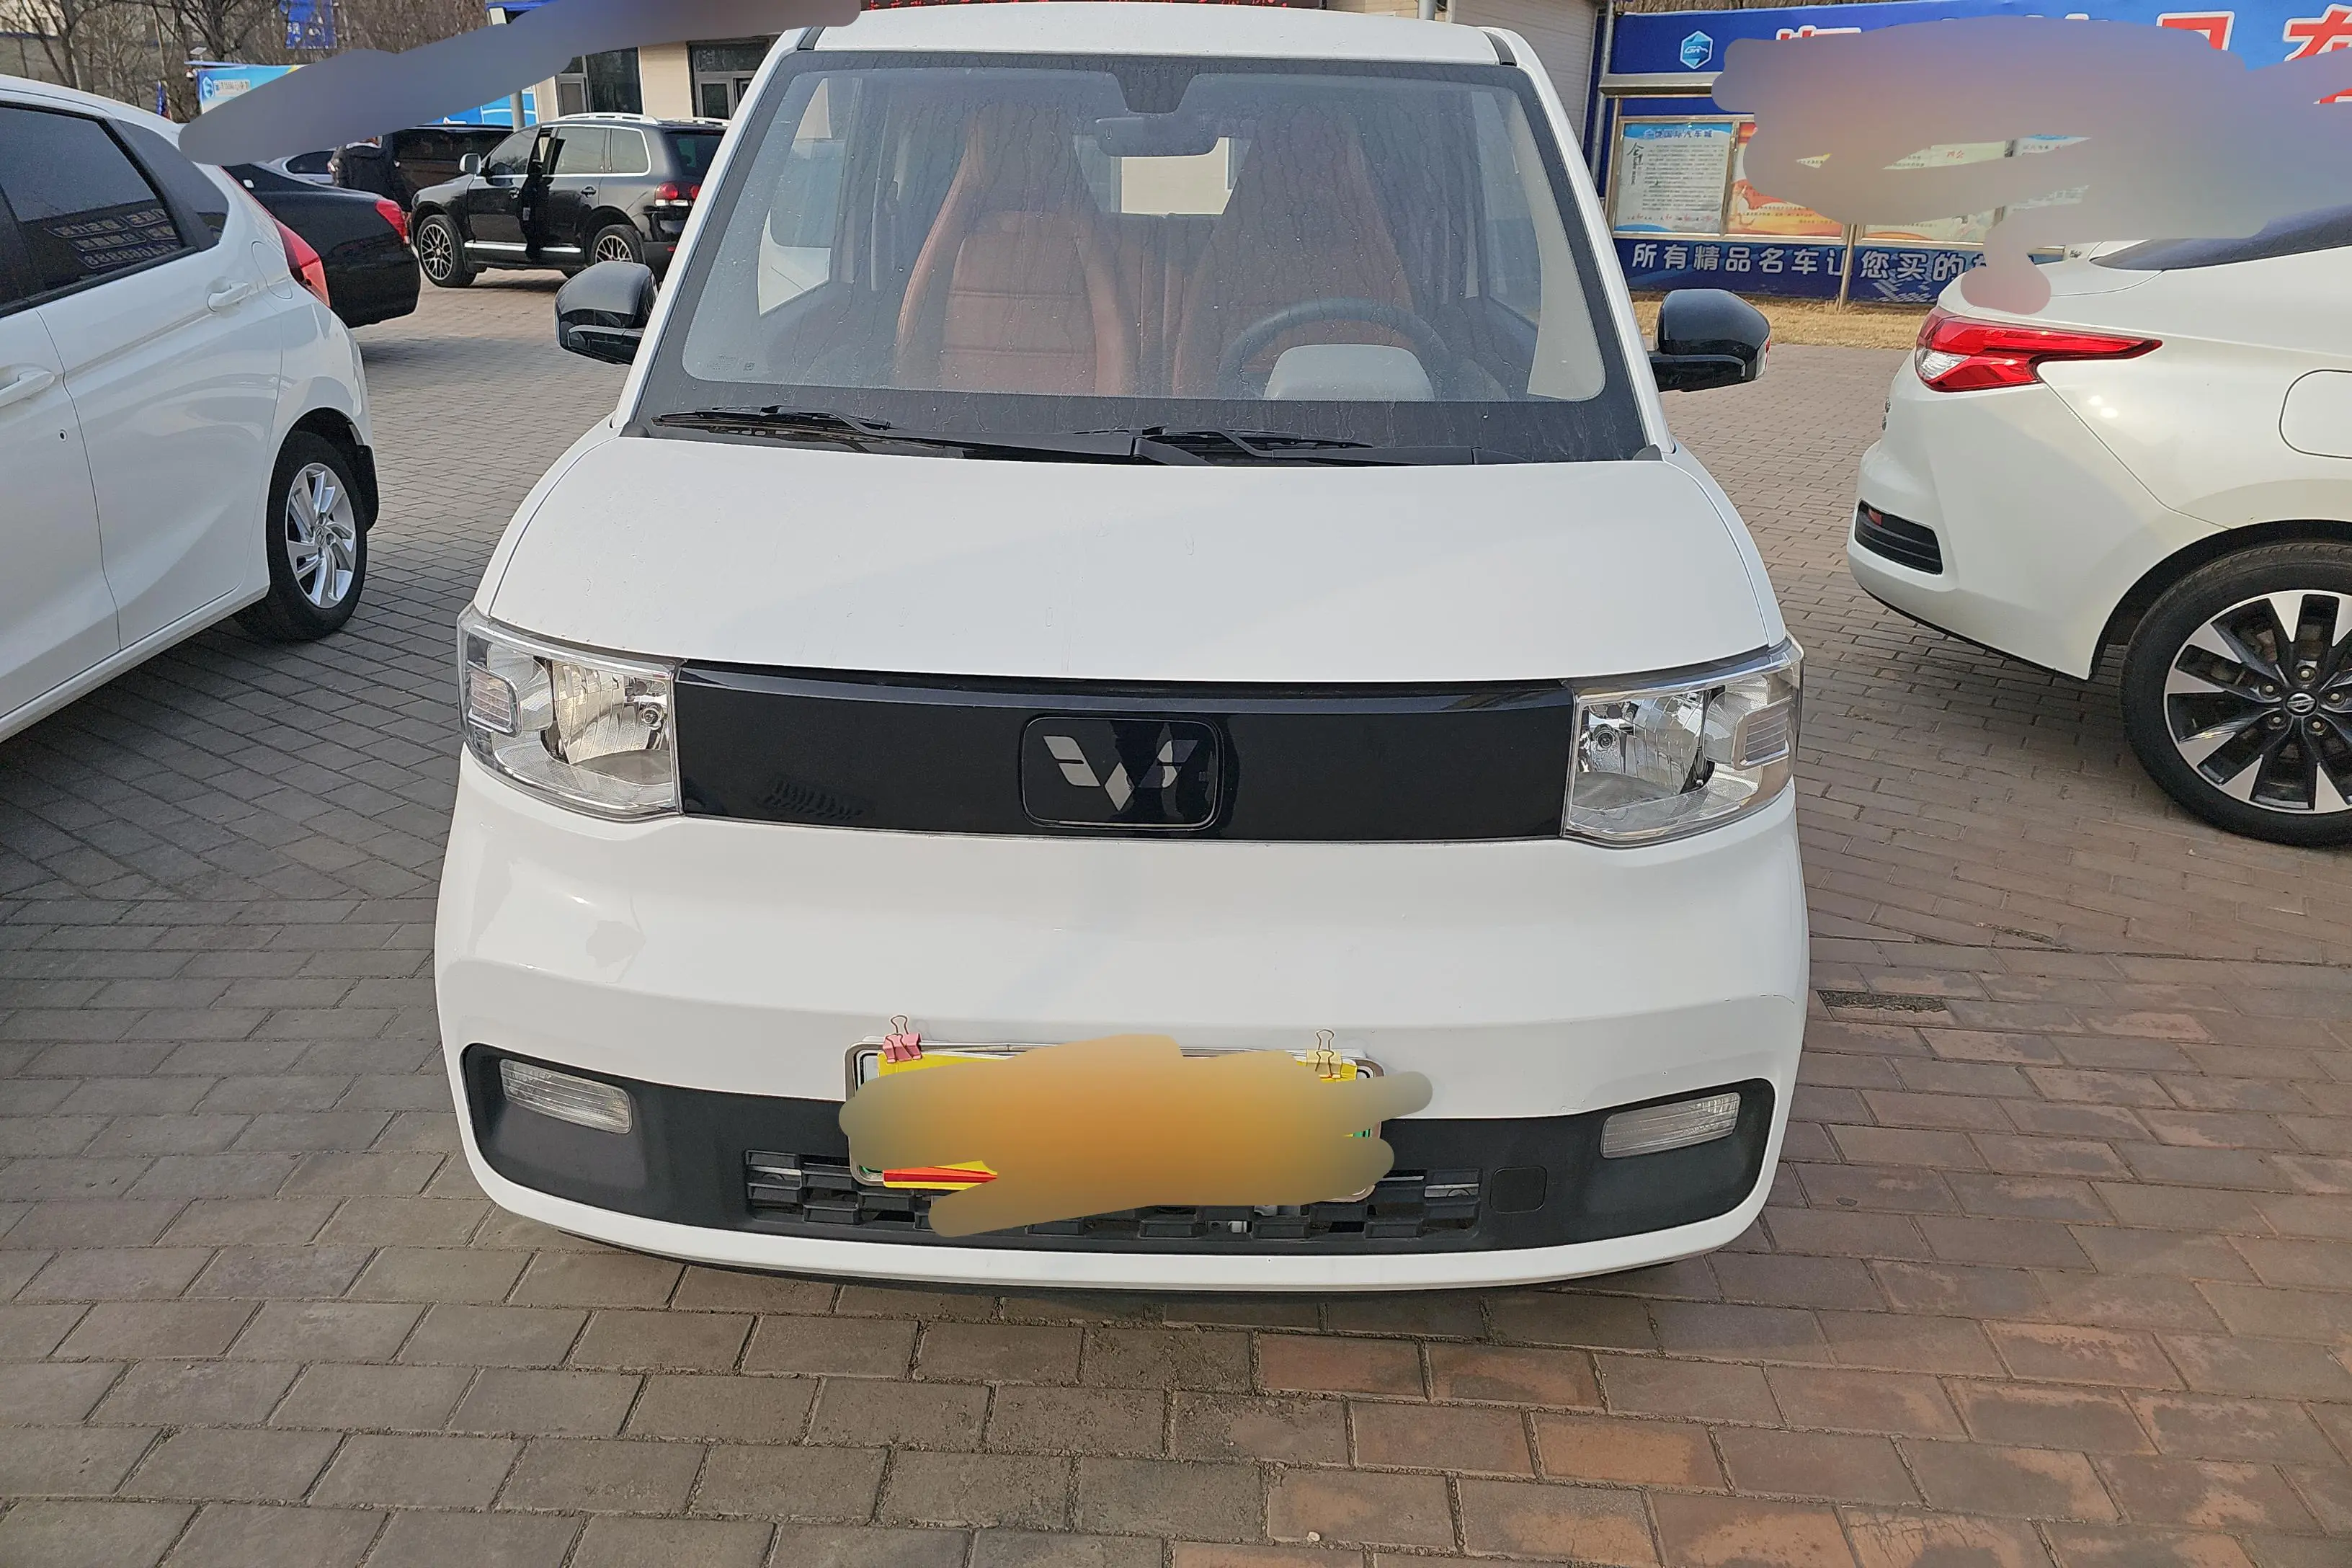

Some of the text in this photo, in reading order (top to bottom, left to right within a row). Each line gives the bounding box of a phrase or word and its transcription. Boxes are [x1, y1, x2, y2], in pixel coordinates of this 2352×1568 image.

[1631, 243, 1987, 282] 所有精品名车让您买的
